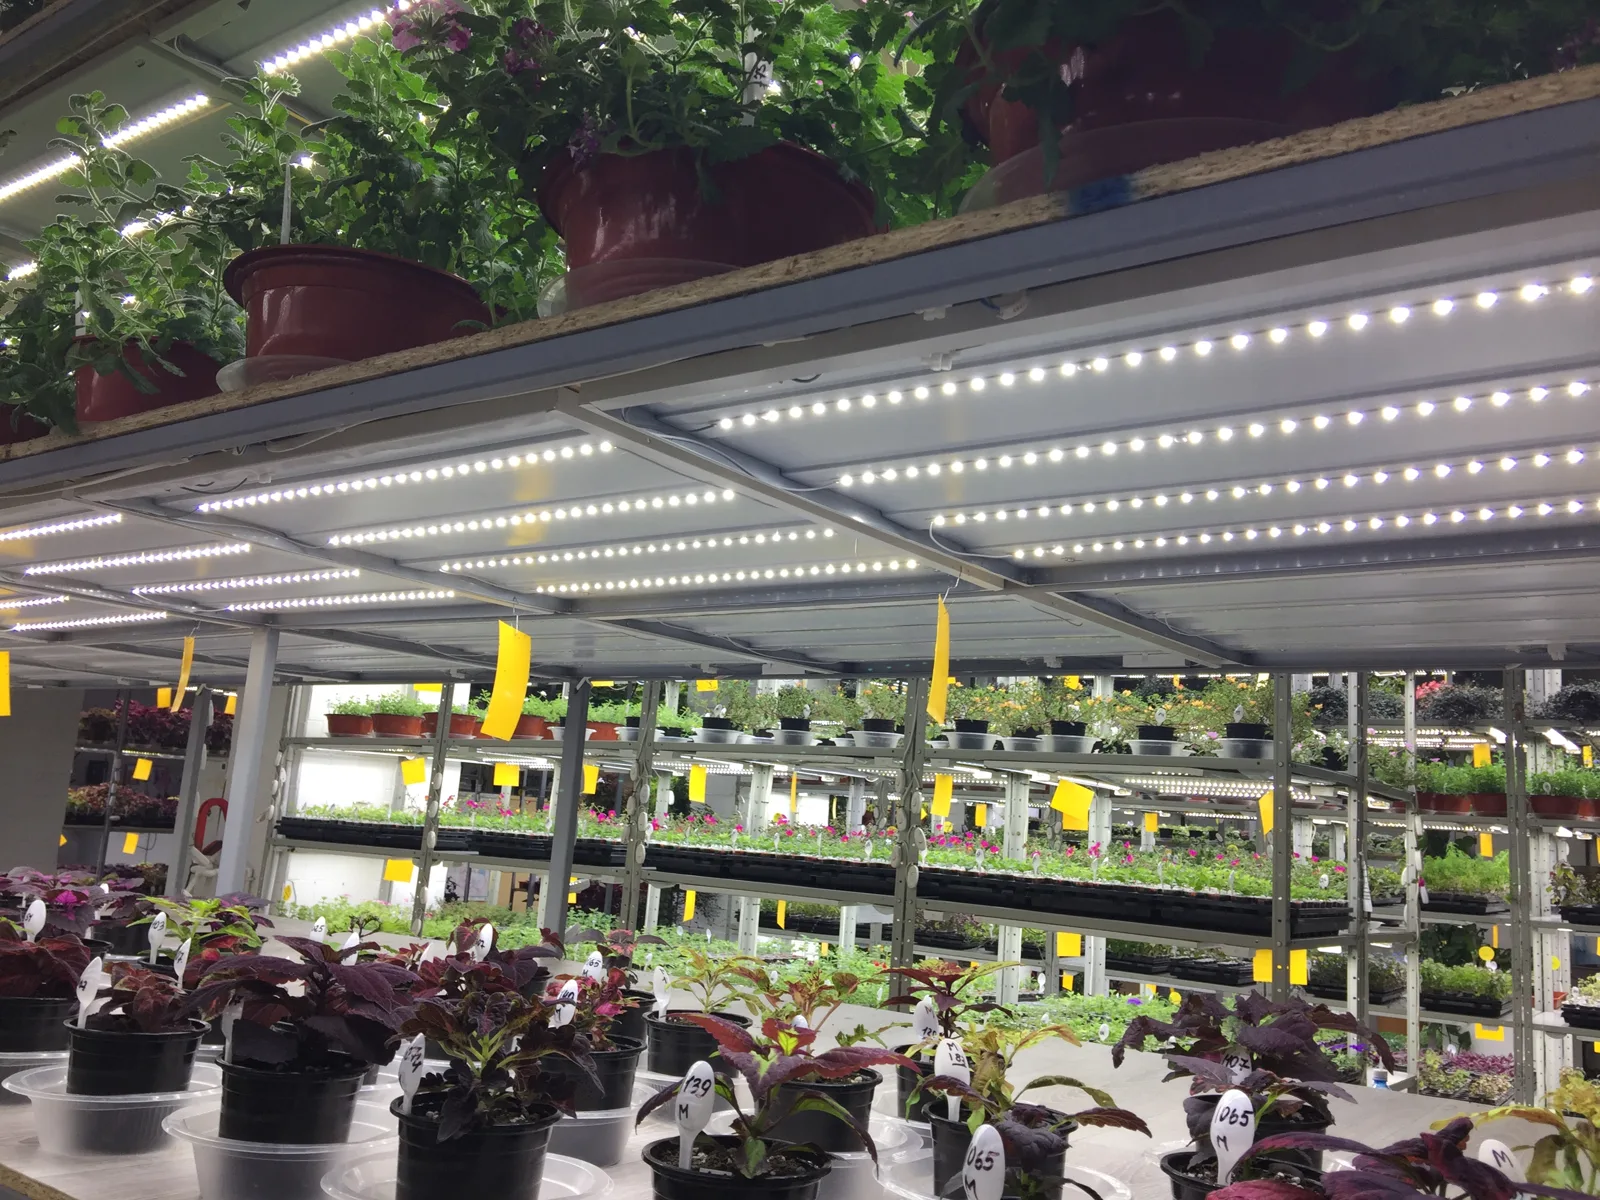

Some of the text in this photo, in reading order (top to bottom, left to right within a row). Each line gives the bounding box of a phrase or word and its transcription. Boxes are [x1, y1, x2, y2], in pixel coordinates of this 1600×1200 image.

[683, 1075, 713, 1097] 139
[678, 1103, 689, 1120] M
[1216, 1134, 1229, 1152] M
[1491, 1149, 1514, 1168] M
